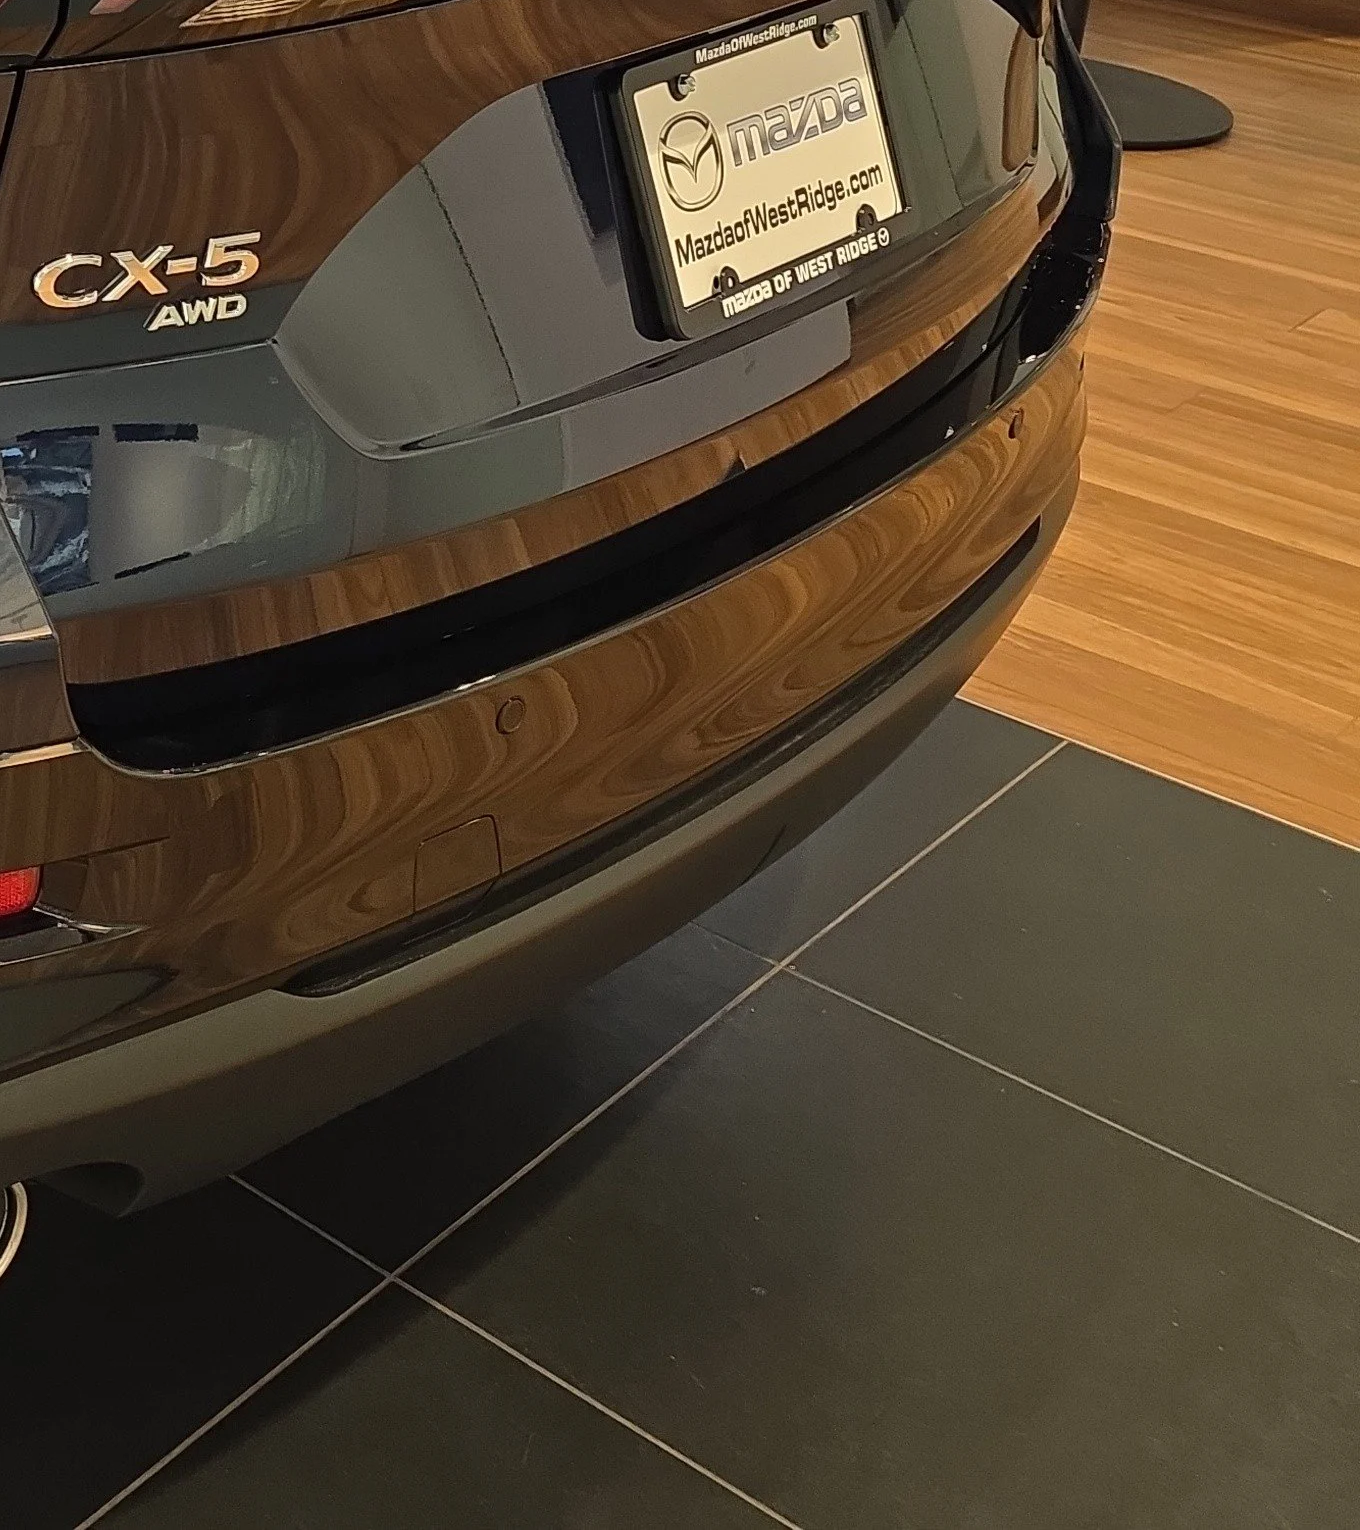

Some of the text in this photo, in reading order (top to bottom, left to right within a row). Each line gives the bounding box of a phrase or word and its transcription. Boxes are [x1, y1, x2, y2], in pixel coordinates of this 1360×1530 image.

[695, 15, 817, 64] MazdaOfWestRidge.com
[674, 164, 884, 267] MazdaofWestRidge.com
[33, 231, 261, 308] CX-5
[773, 270, 793, 294] OF
[794, 252, 834, 284] WEST
[836, 233, 878, 266] RIDGE
[143, 292, 247, 331] AWD
